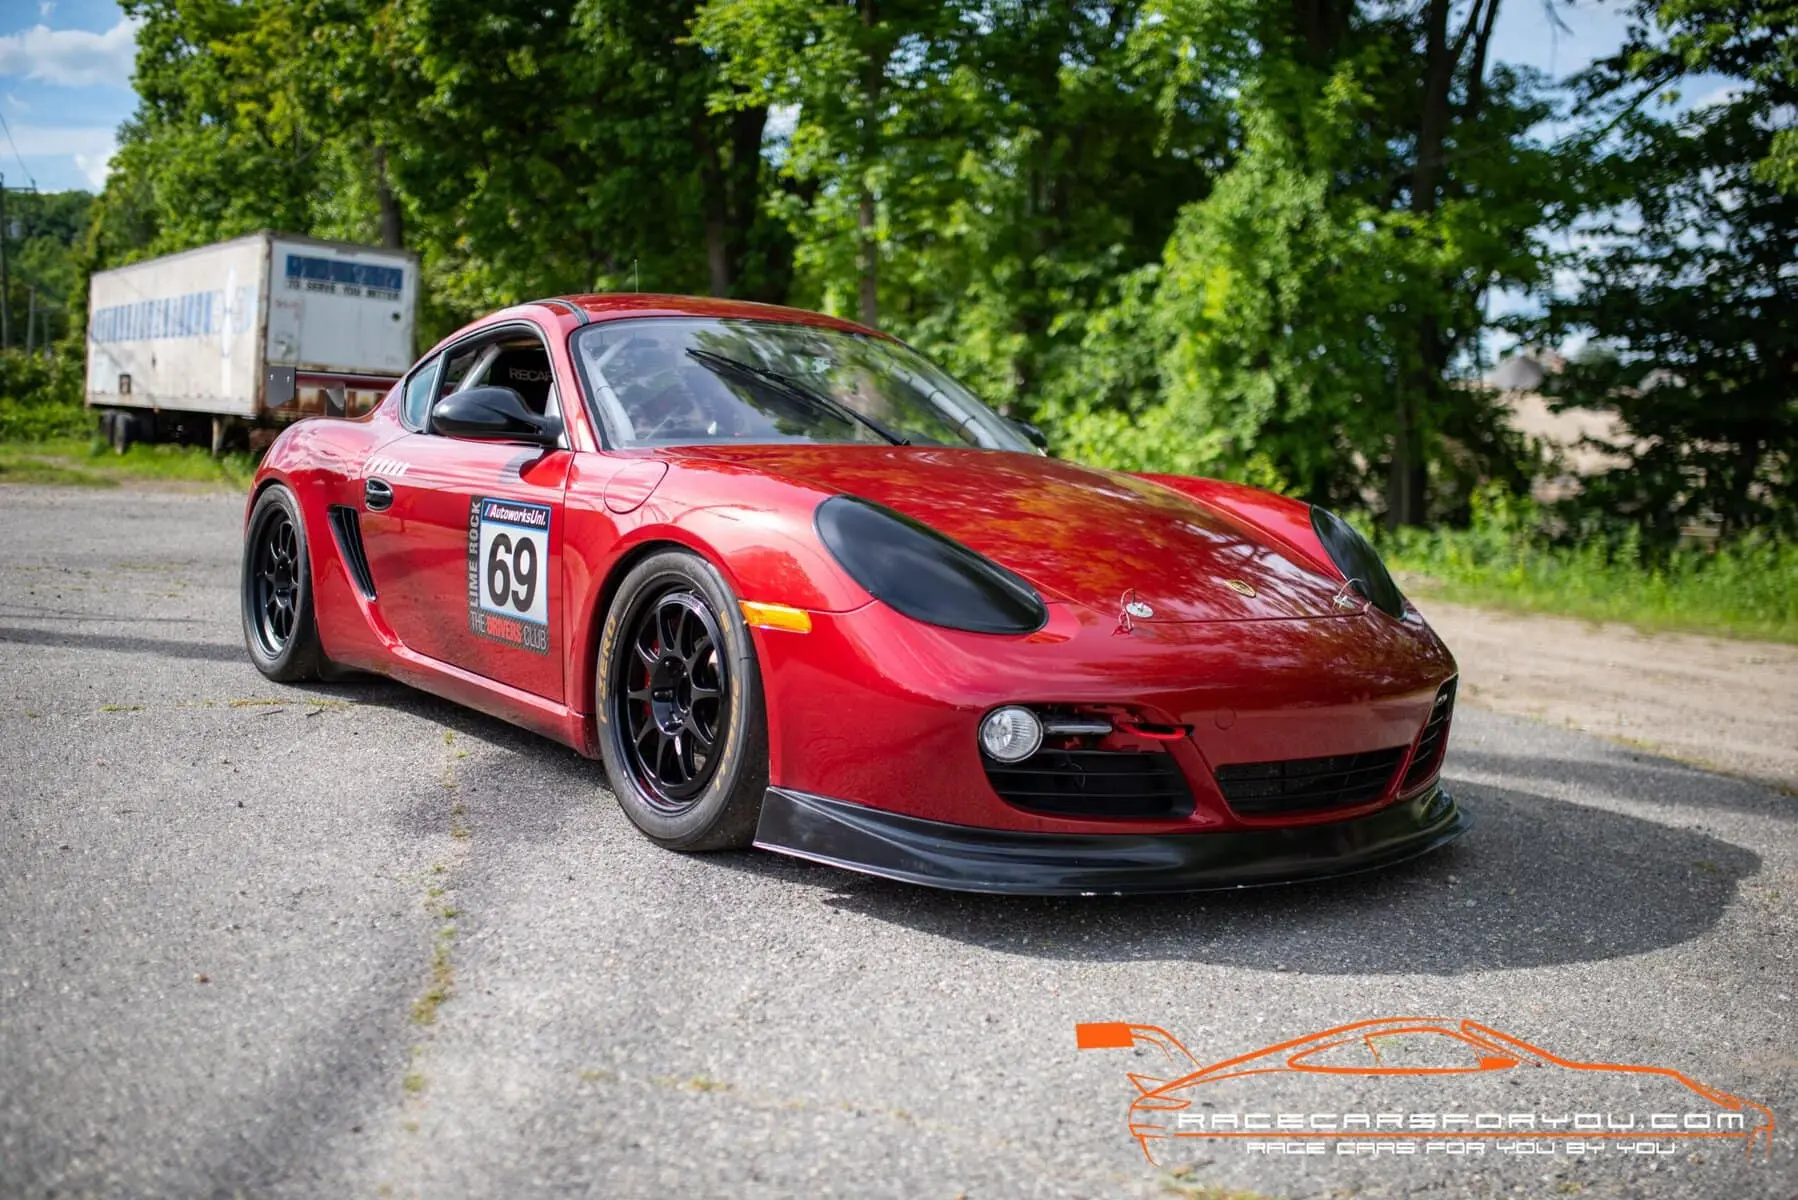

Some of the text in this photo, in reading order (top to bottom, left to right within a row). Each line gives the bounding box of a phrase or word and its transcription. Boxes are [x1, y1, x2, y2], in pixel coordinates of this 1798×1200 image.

[306, 282, 336, 293] SERVE
[342, 286, 361, 297] YOU
[468, 501, 481, 608] LIME ROCK
[488, 533, 538, 612] 69
[470, 610, 485, 633] THE
[523, 625, 547, 650] CLUB
[599, 615, 617, 701] ZERO
